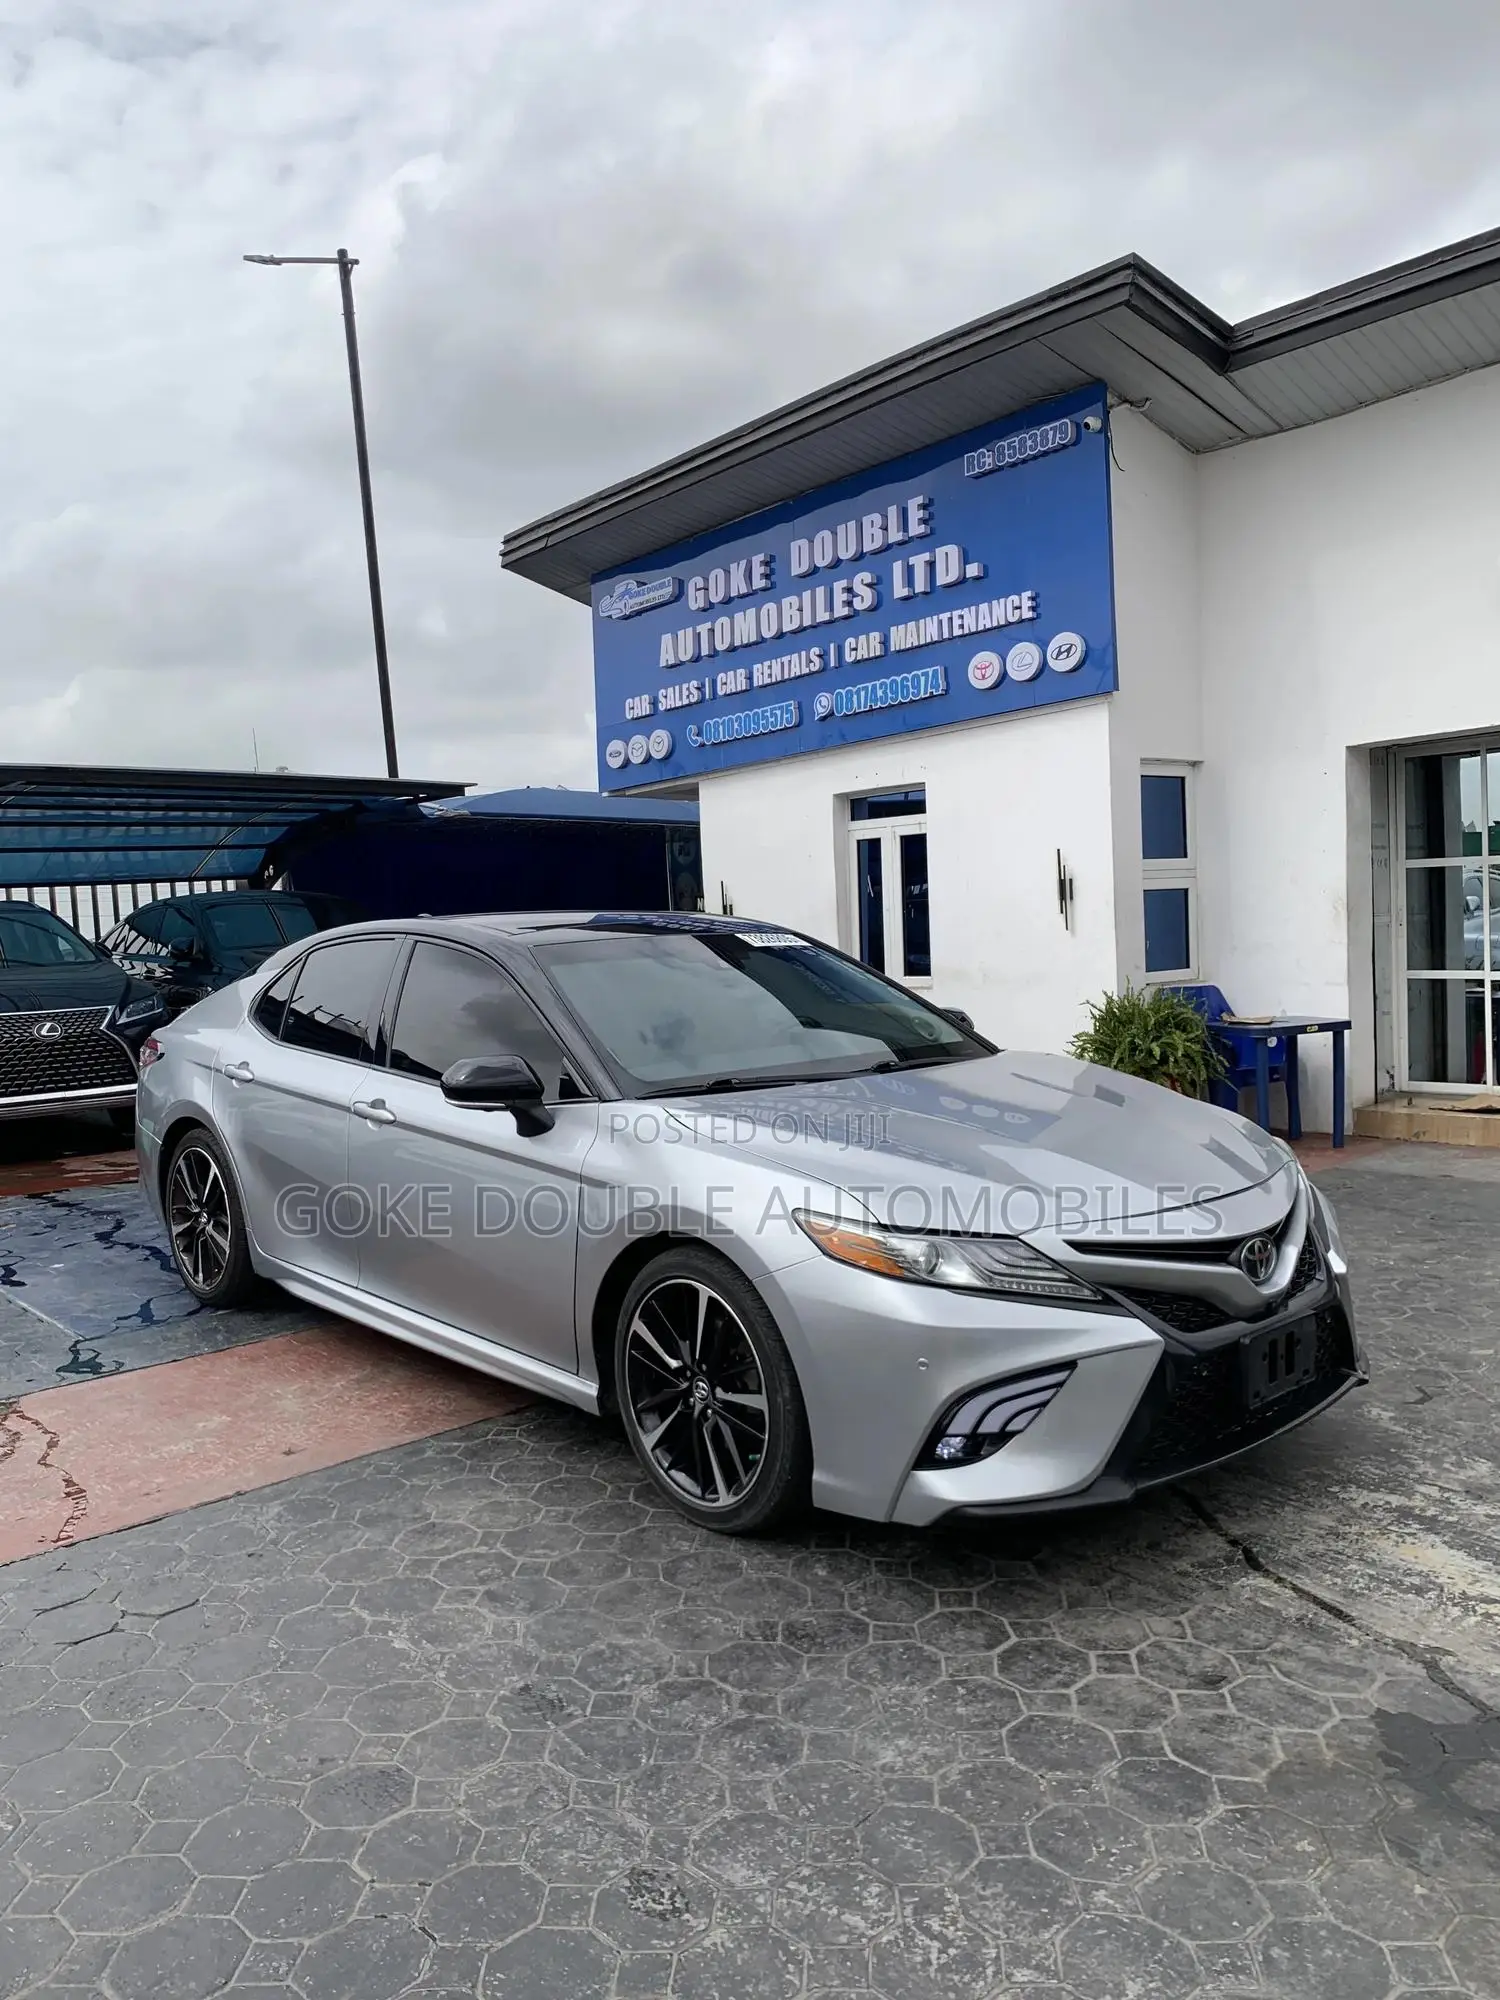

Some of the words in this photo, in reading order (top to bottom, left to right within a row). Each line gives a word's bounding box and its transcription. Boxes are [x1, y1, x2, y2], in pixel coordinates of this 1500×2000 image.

[965, 449, 993, 476] RC:
[688, 553, 770, 611] GOKE
[790, 495, 928, 576] DOUBLE
[660, 572, 876, 667] AUTOMOBILES
[893, 544, 983, 599] LTD.
[625, 695, 652, 719] CAR
[658, 680, 700, 711] SALES
[717, 668, 750, 696] CAR
[753, 647, 823, 687] RENTALS
[844, 631, 884, 663] CAR
[890, 590, 1036, 651] MAINTENANCE
[833, 665, 943, 717] 08174396974
[703, 700, 796, 745] 08103095575
